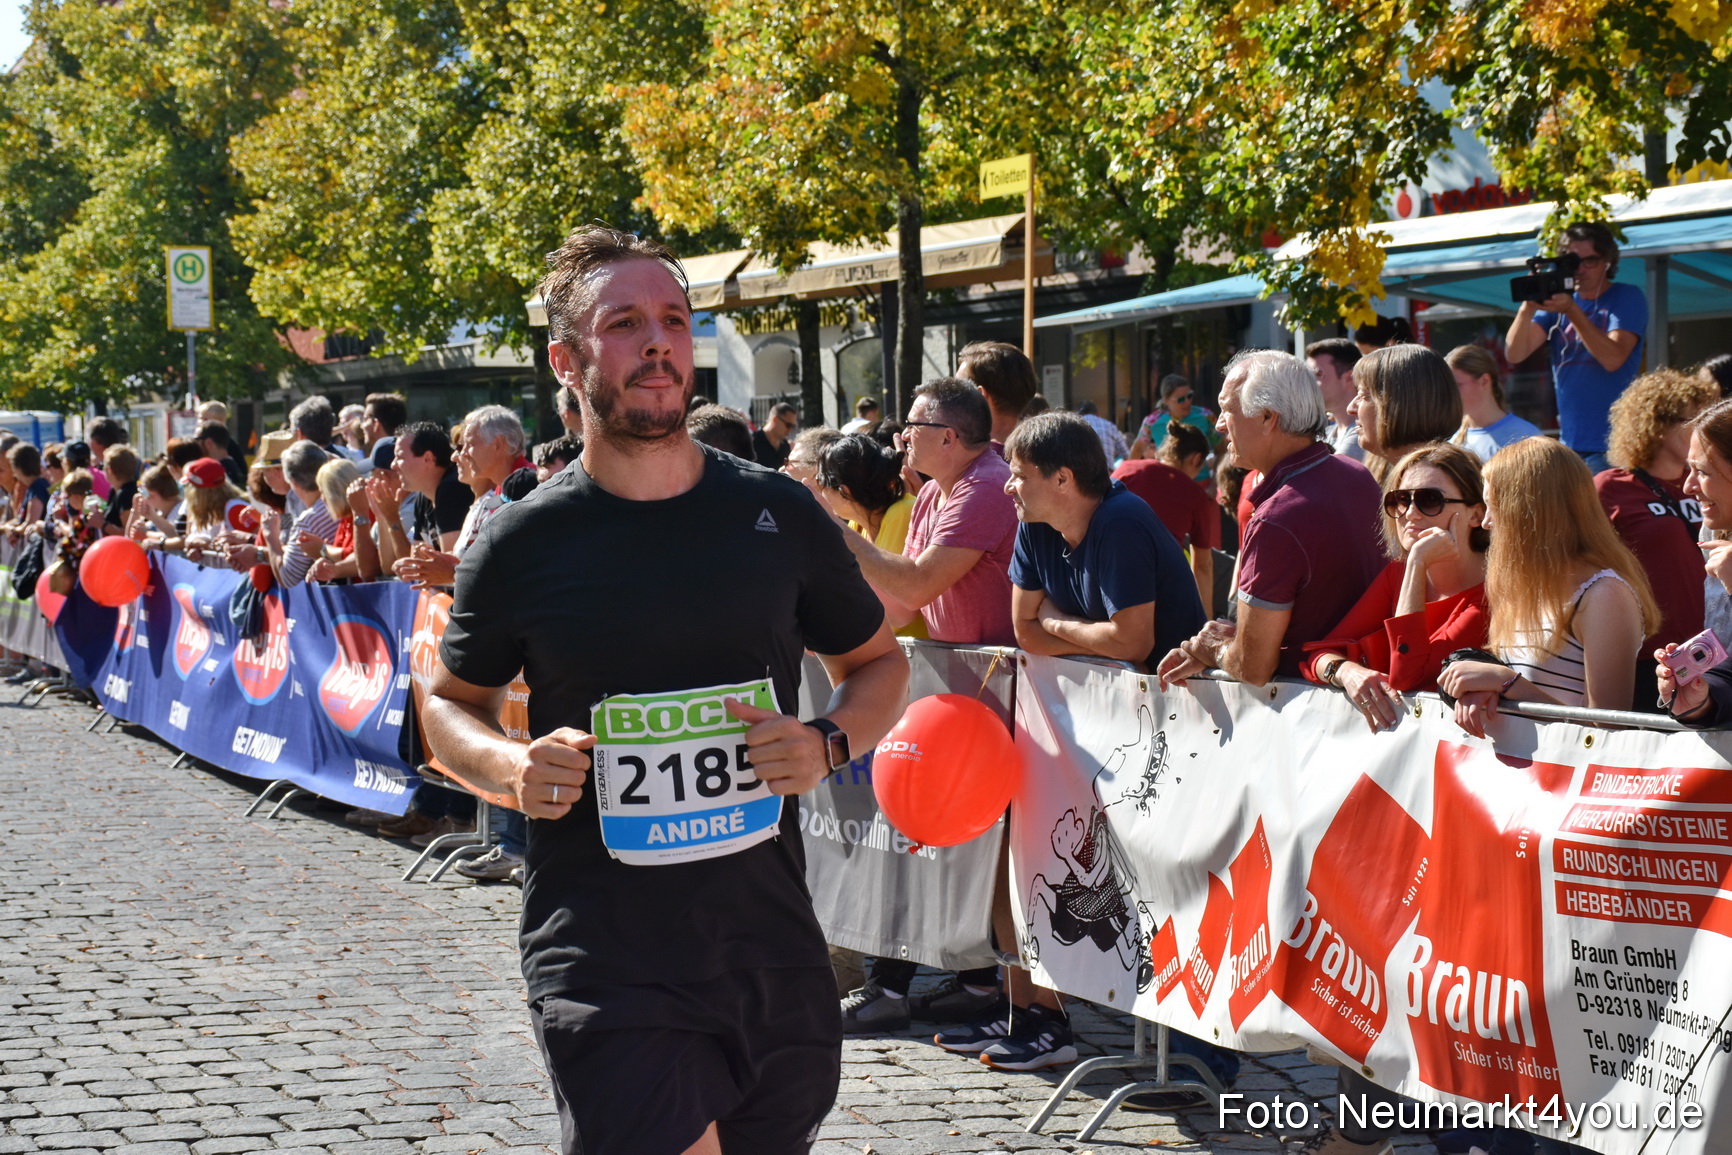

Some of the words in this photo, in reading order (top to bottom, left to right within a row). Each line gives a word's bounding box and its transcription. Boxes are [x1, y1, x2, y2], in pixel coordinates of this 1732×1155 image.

[990, 169, 1027, 187] Toiletten
[617, 743, 765, 805] 2185
[1590, 772, 1684, 796] BINDESTRICKE
[646, 807, 745, 844] ANDRÉ
[1571, 808, 1730, 840] VERZURRSYSTEME
[1402, 885, 1418, 907] Seit
[1413, 856, 1429, 887] 1929
[1562, 847, 1719, 883] RUNDSCHLINGEN
[1565, 890, 1693, 923] HEBEBÄNDER
[1281, 888, 1381, 1014] Braun
[1570, 939, 1619, 966] Braun
[1623, 945, 1678, 971] GmbH
[1310, 977, 1340, 1007] Sicher
[1336, 993, 1352, 1018] ist
[1405, 933, 1538, 1049] Braun
[1574, 966, 1599, 989] Am
[1603, 969, 1679, 1003] Grünberg
[1682, 979, 1689, 1002] 8
[1576, 992, 1643, 1019] D-92318
[1453, 1041, 1492, 1069] Sicher
[1496, 1052, 1515, 1072] ist
[1516, 1060, 1560, 1082] sicher
[1583, 1028, 1615, 1052] Tel.
[1617, 1032, 1656, 1061] 09181
[1589, 1054, 1618, 1078] Fax
[1621, 1059, 1654, 1089] 09181
